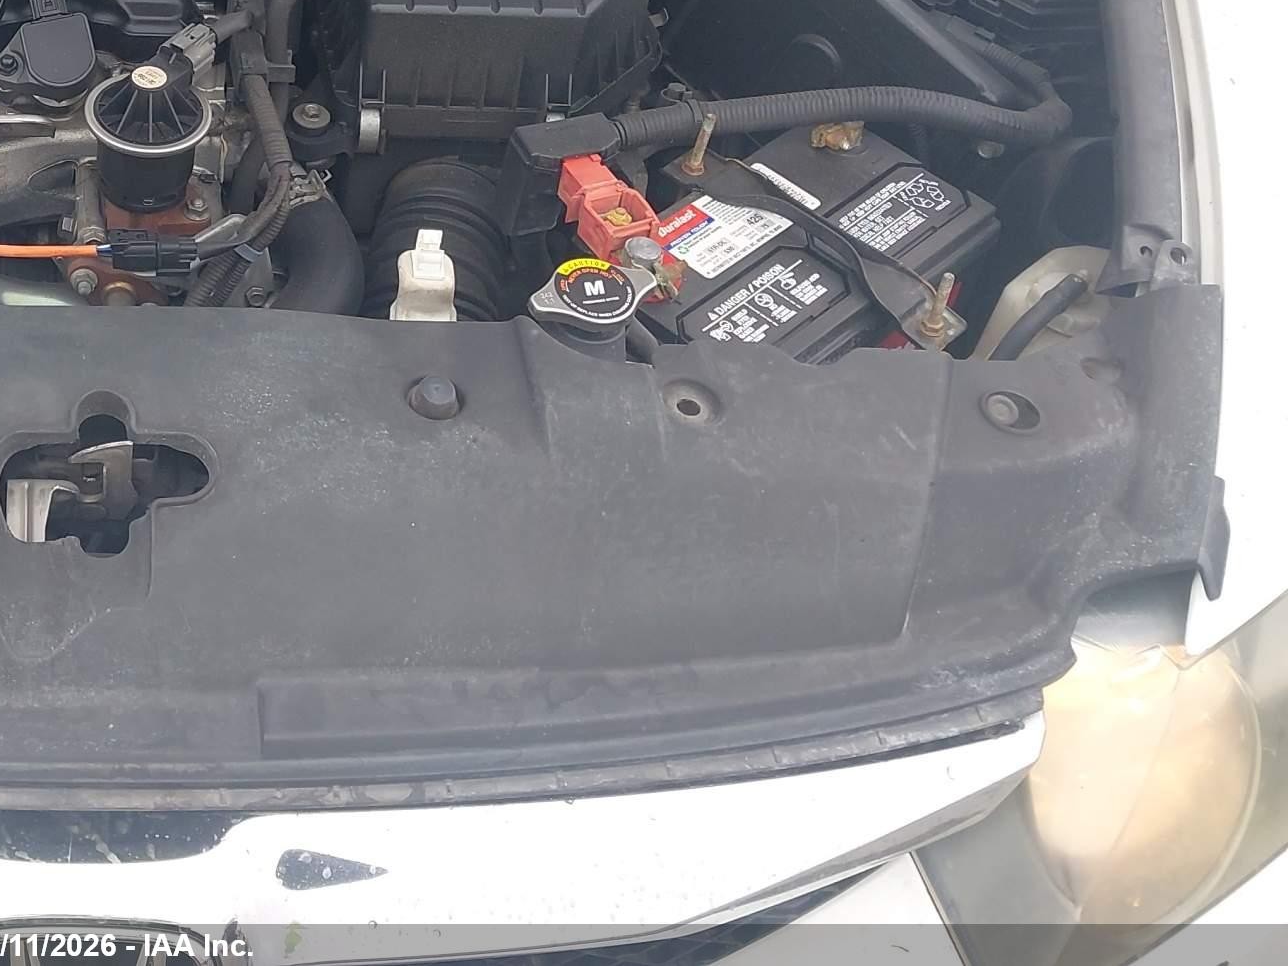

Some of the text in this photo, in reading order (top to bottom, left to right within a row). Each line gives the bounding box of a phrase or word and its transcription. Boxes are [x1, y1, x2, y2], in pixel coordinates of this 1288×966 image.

[568, 260, 606, 269] CAUTION
[584, 280, 606, 296] M
[714, 288, 750, 317] DANGER
[752, 263, 785, 288] POISON
